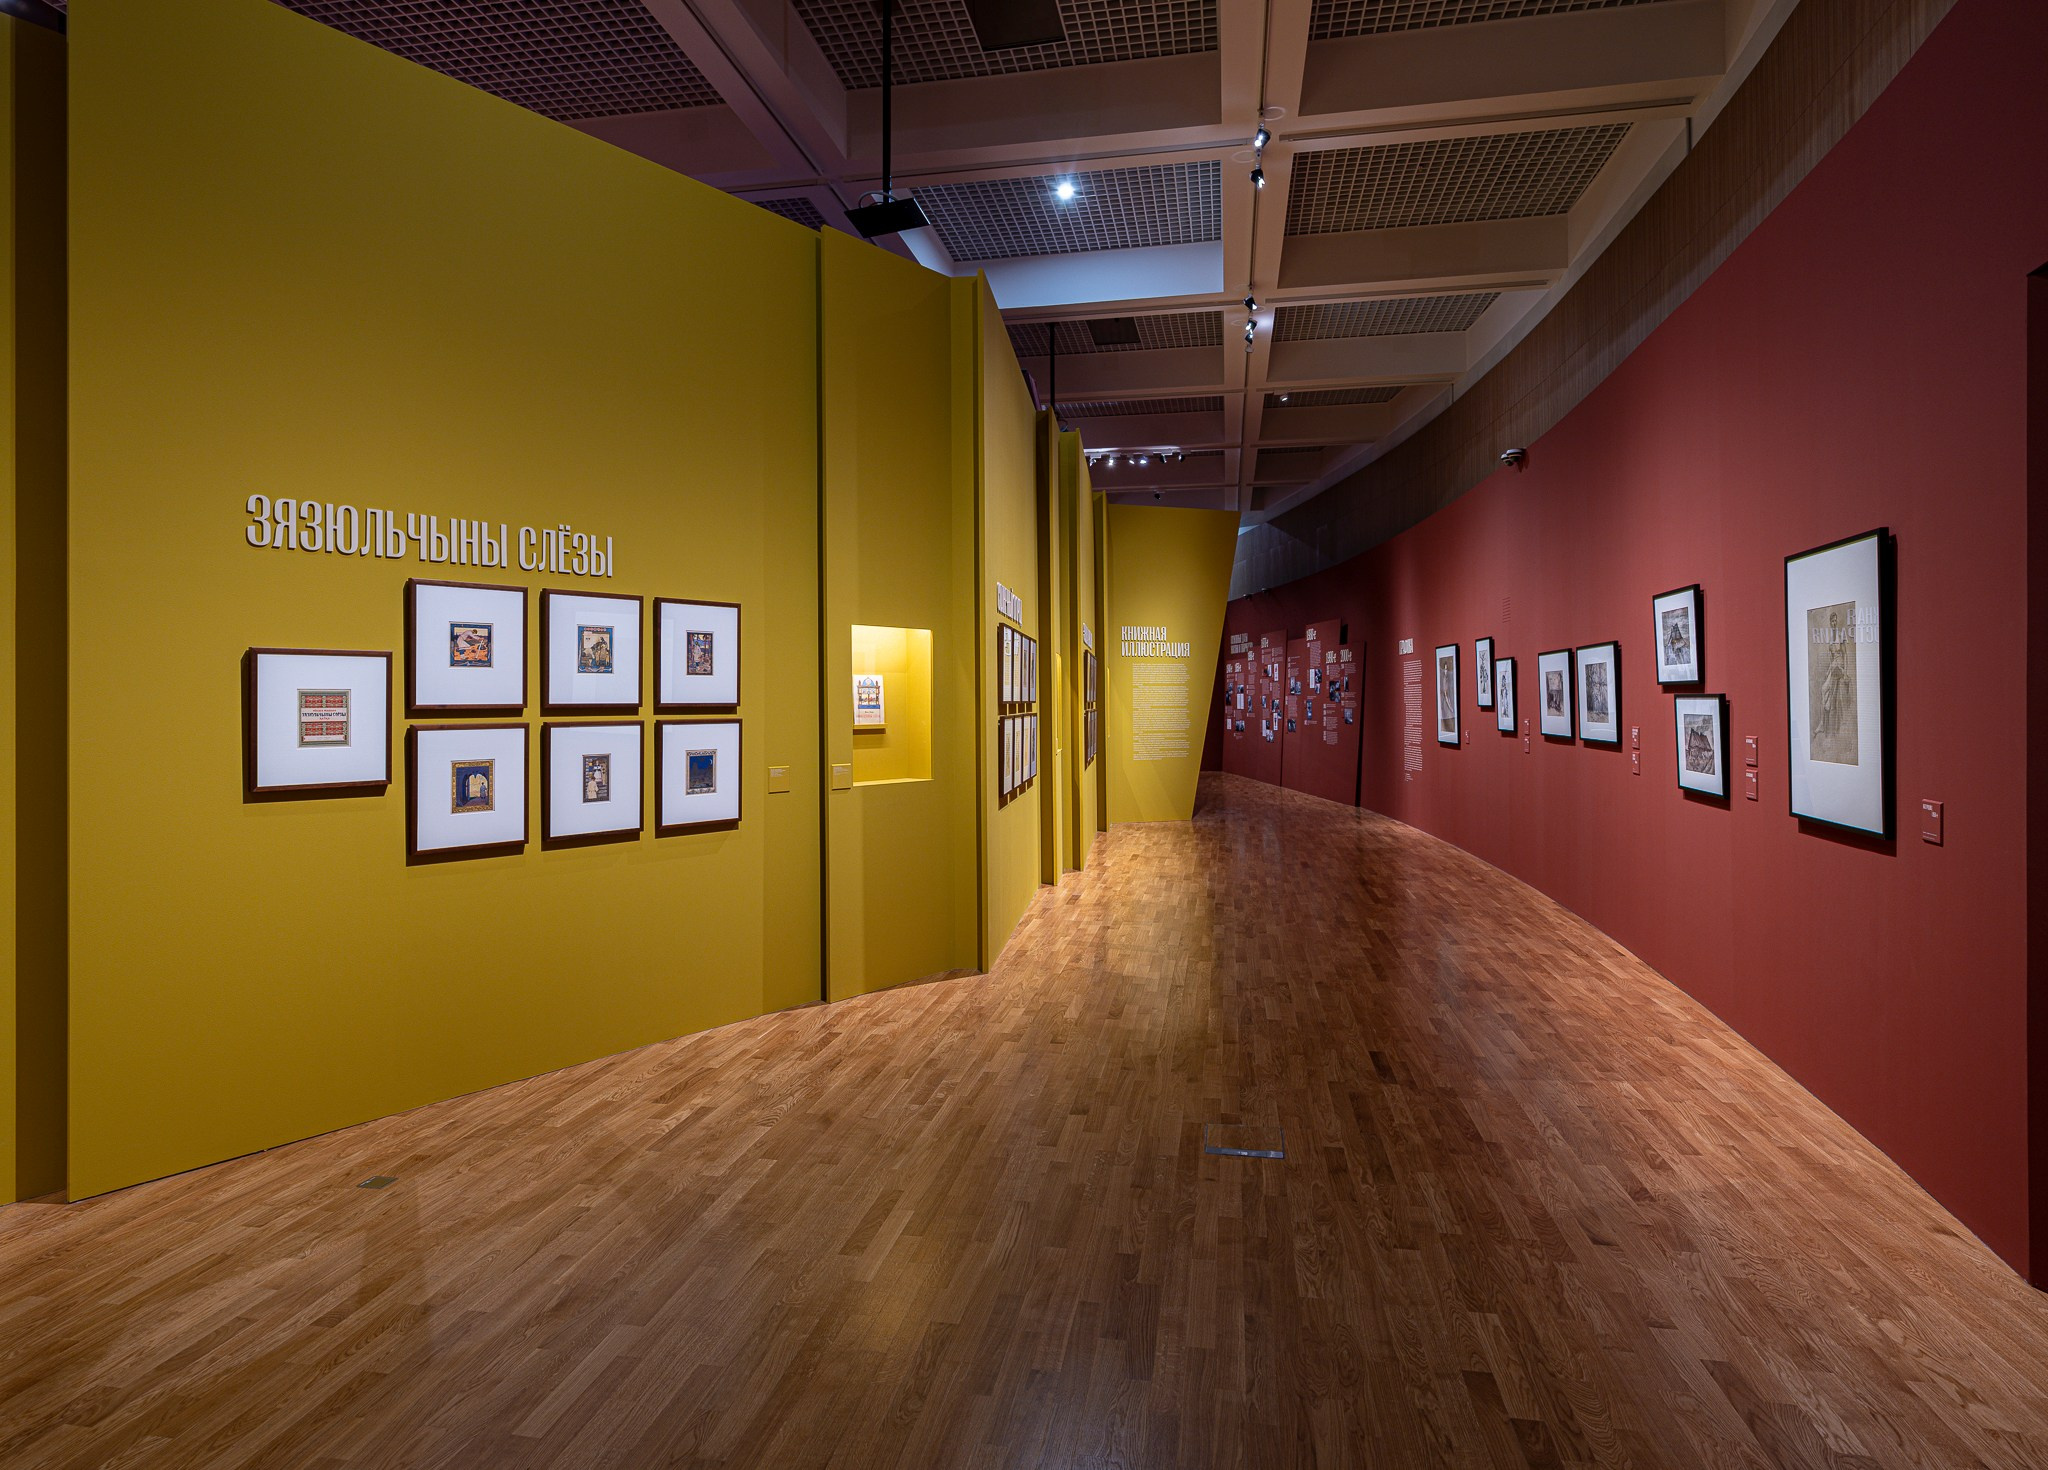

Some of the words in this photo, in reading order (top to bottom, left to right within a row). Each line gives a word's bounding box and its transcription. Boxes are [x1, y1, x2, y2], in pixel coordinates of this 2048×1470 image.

[246, 494, 507, 568] ЗЯЗЮЛЬЧЫНЫ
[518, 524, 613, 577] СЛЁЗЫ
[1121, 626, 1167, 641] КНИЖНАЯ
[1121, 641, 1190, 658] ИЛЛЮСТРАЦИЯ
